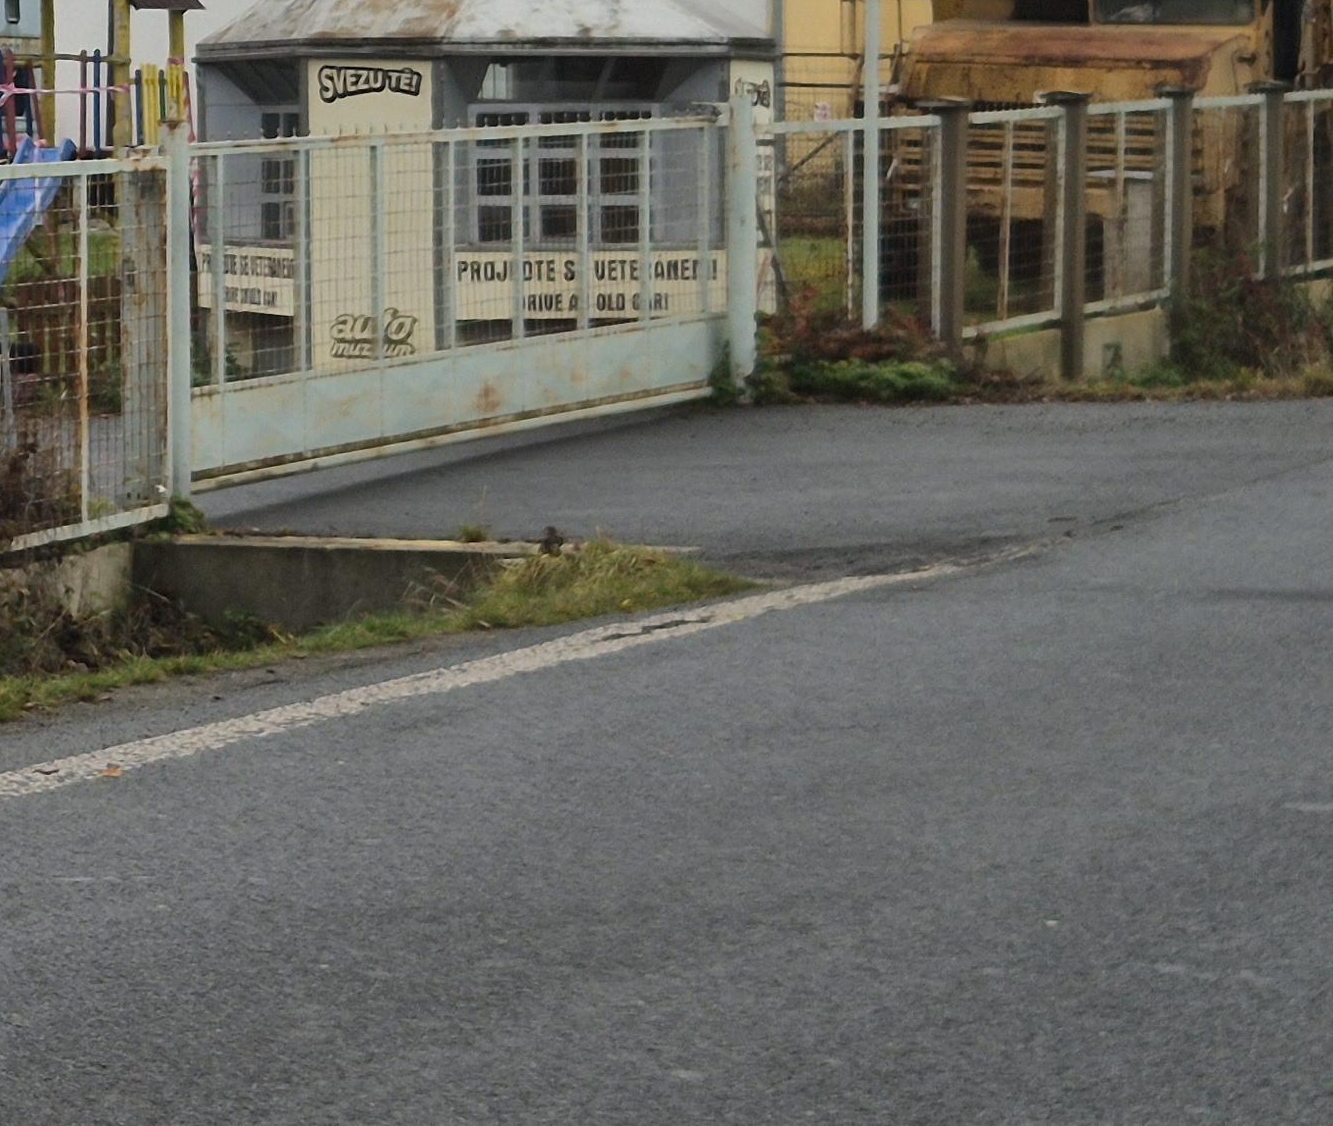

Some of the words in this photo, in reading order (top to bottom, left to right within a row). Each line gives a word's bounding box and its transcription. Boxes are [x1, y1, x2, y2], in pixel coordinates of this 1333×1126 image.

[319, 66, 384, 100] SVEZU
[387, 67, 420, 94] TĚ!
[523, 293, 563, 312] RIVE
[596, 292, 626, 312] OLD
[331, 307, 417, 341] auo
